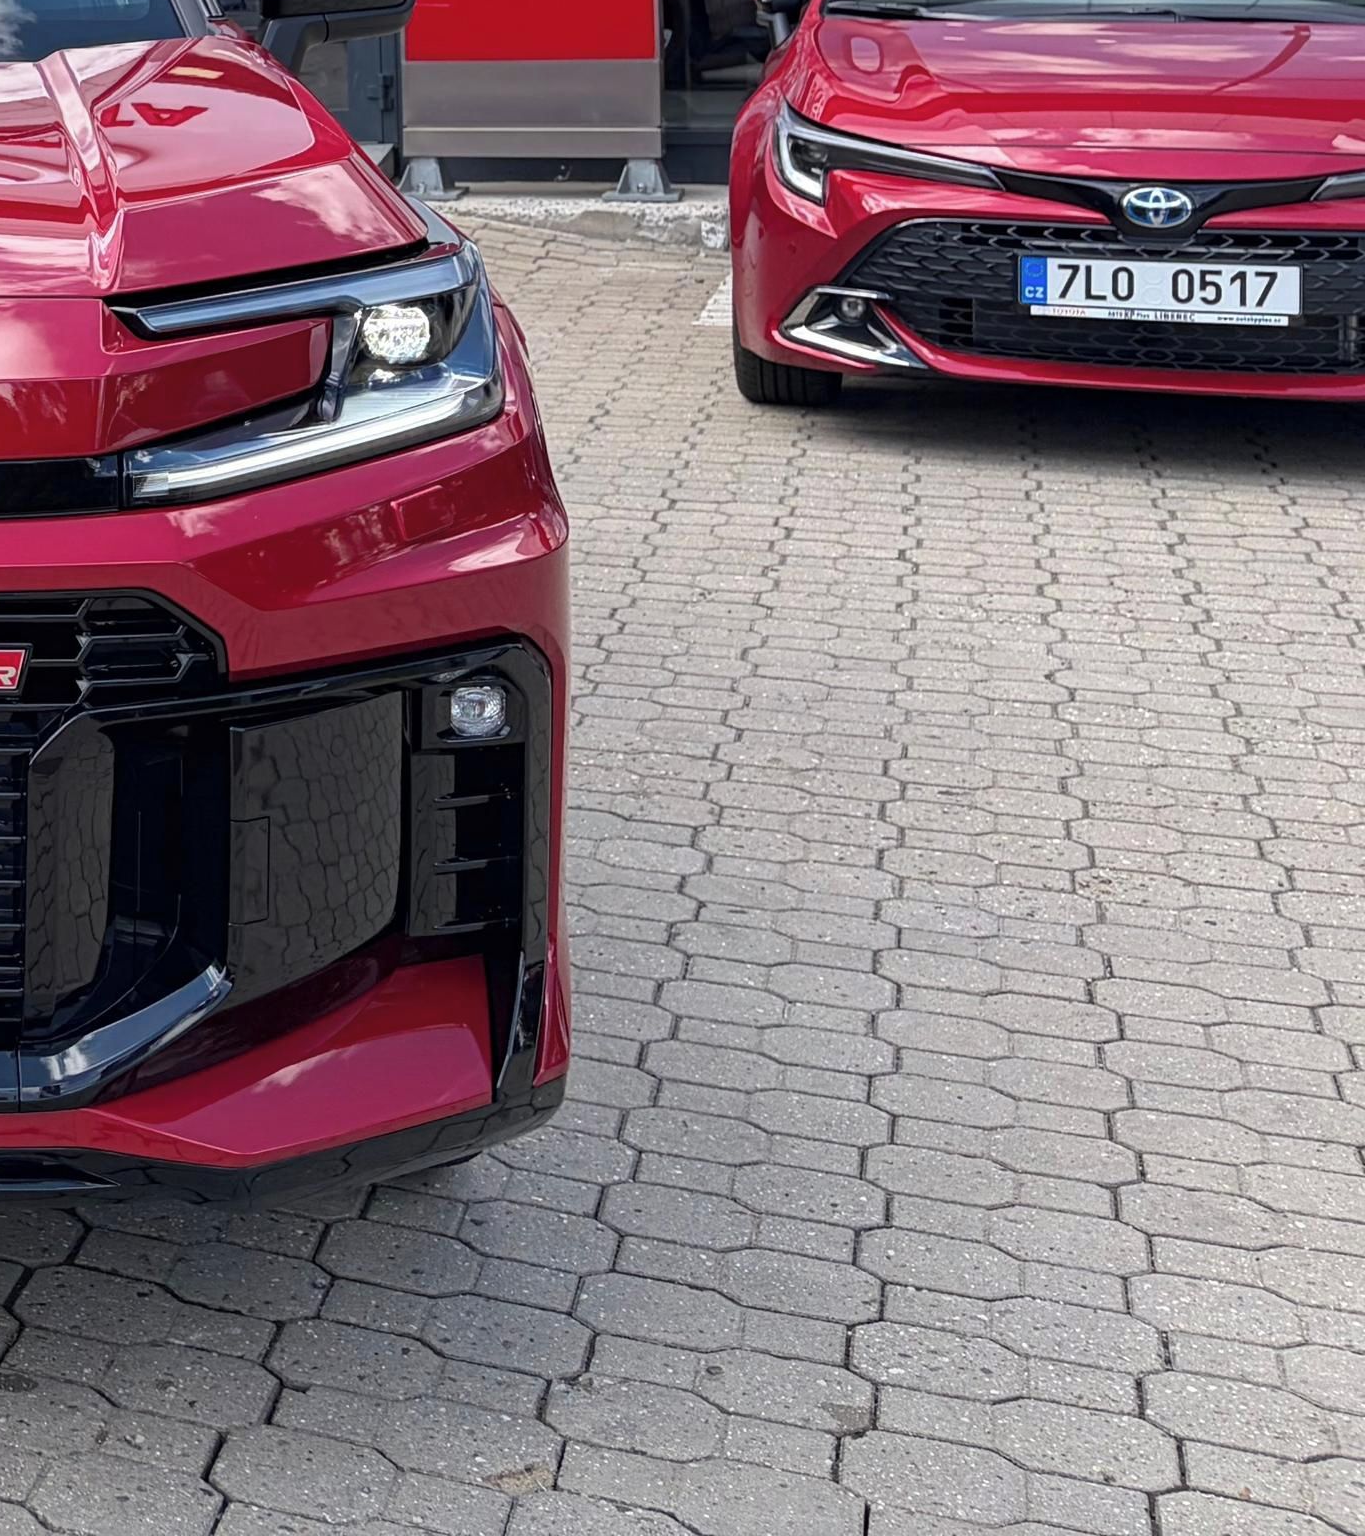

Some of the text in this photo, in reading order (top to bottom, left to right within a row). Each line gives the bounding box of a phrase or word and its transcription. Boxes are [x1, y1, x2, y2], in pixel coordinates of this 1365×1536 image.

[1025, 287, 1045, 298] CZ
[1172, 269, 1279, 308] 0517
[1154, 312, 1196, 323] LIBEREC
